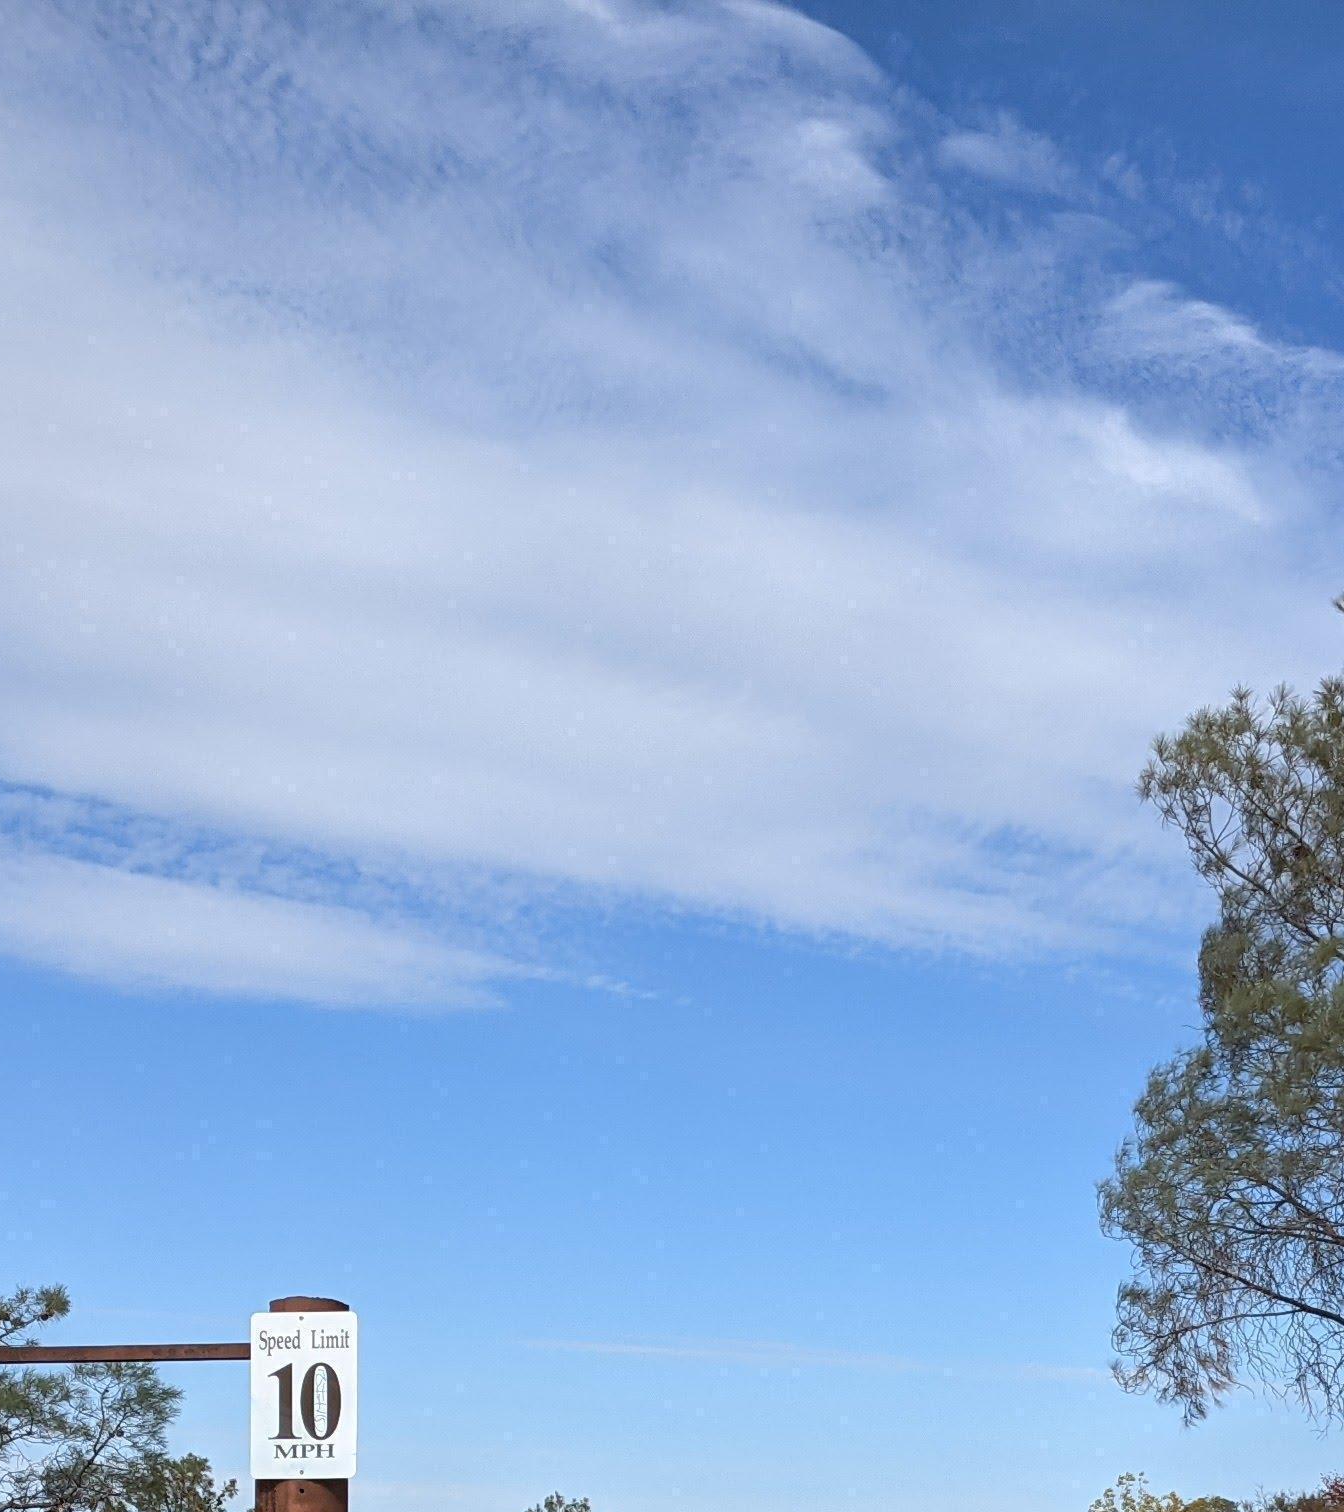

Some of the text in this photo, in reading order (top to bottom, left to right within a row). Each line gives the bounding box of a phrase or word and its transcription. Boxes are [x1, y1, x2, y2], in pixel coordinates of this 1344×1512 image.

[259, 1329, 350, 1356] Speed Limit
[268, 1362, 342, 1440] 10
[274, 1444, 335, 1459] MPH
